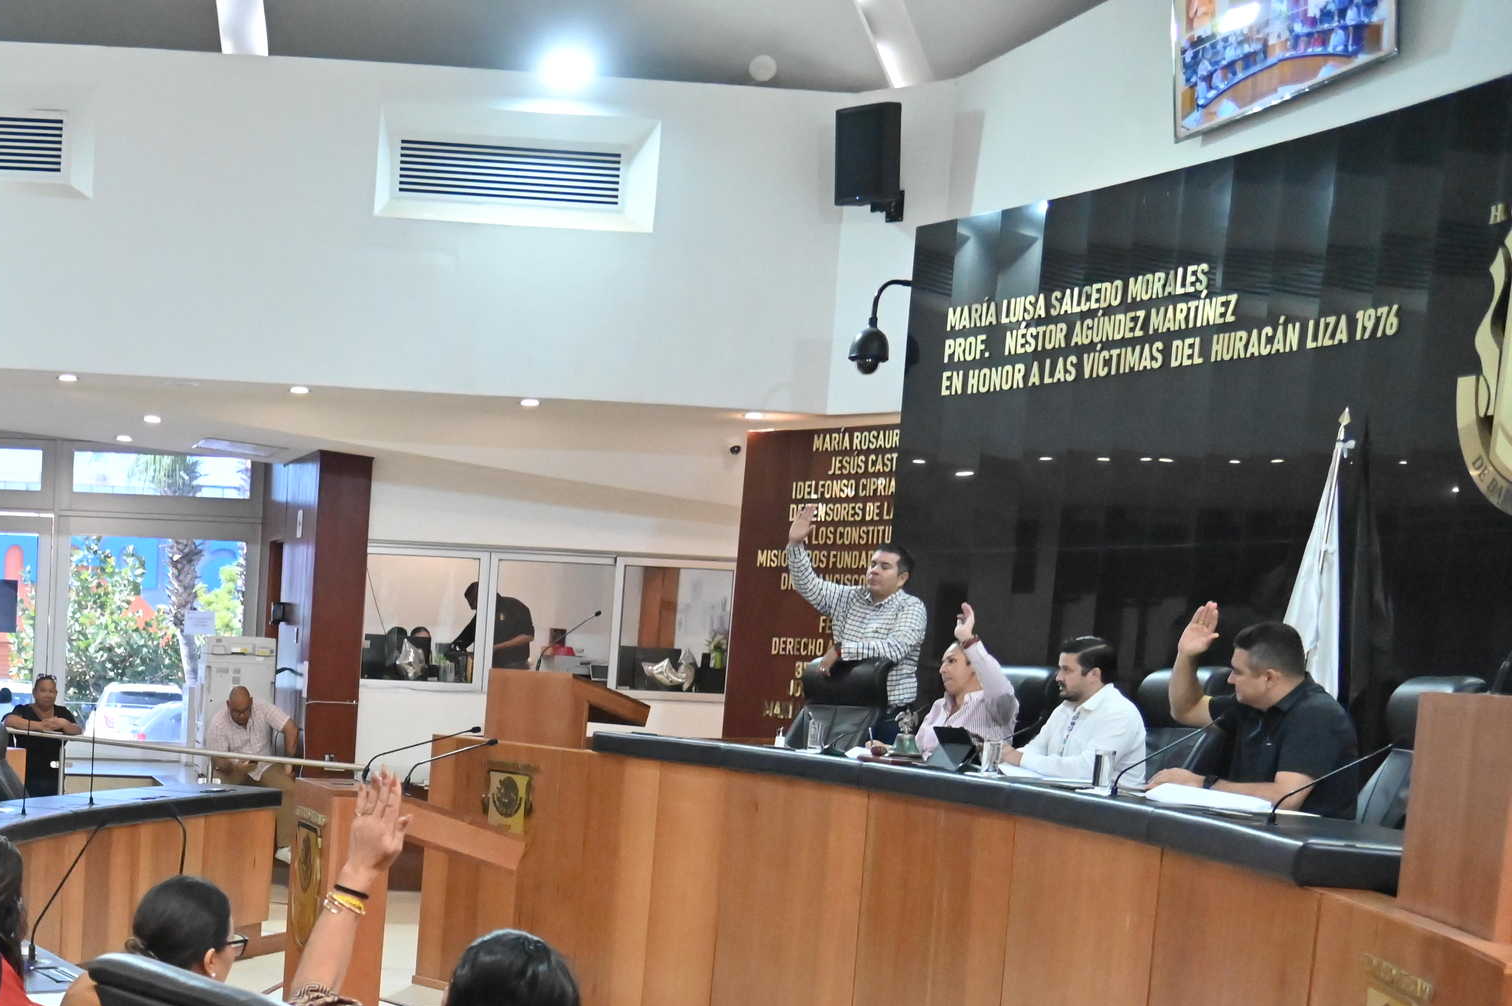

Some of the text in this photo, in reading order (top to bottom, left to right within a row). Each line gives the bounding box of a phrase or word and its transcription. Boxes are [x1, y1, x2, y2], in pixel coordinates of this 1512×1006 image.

[946, 263, 1210, 331] MARÍA LUISA SALCEDO MORALES
[943, 289, 1238, 363] PROF. NÉSTOR AGÚNDEZ MARTÍNEZ
[941, 304, 1400, 396] EN HONOR A LAS VÍCTIMAS DEL HURACÁN LIZA 1976
[813, 426, 850, 452] MARÍA
[828, 451, 898, 475] JESÚS CAST
[792, 477, 896, 499] IDELFONSO CIPRIA
[865, 502, 880, 521] DE
[812, 525, 834, 544] LOS
[837, 525, 892, 544] CONSTITU
[771, 637, 823, 656] DERECHO
